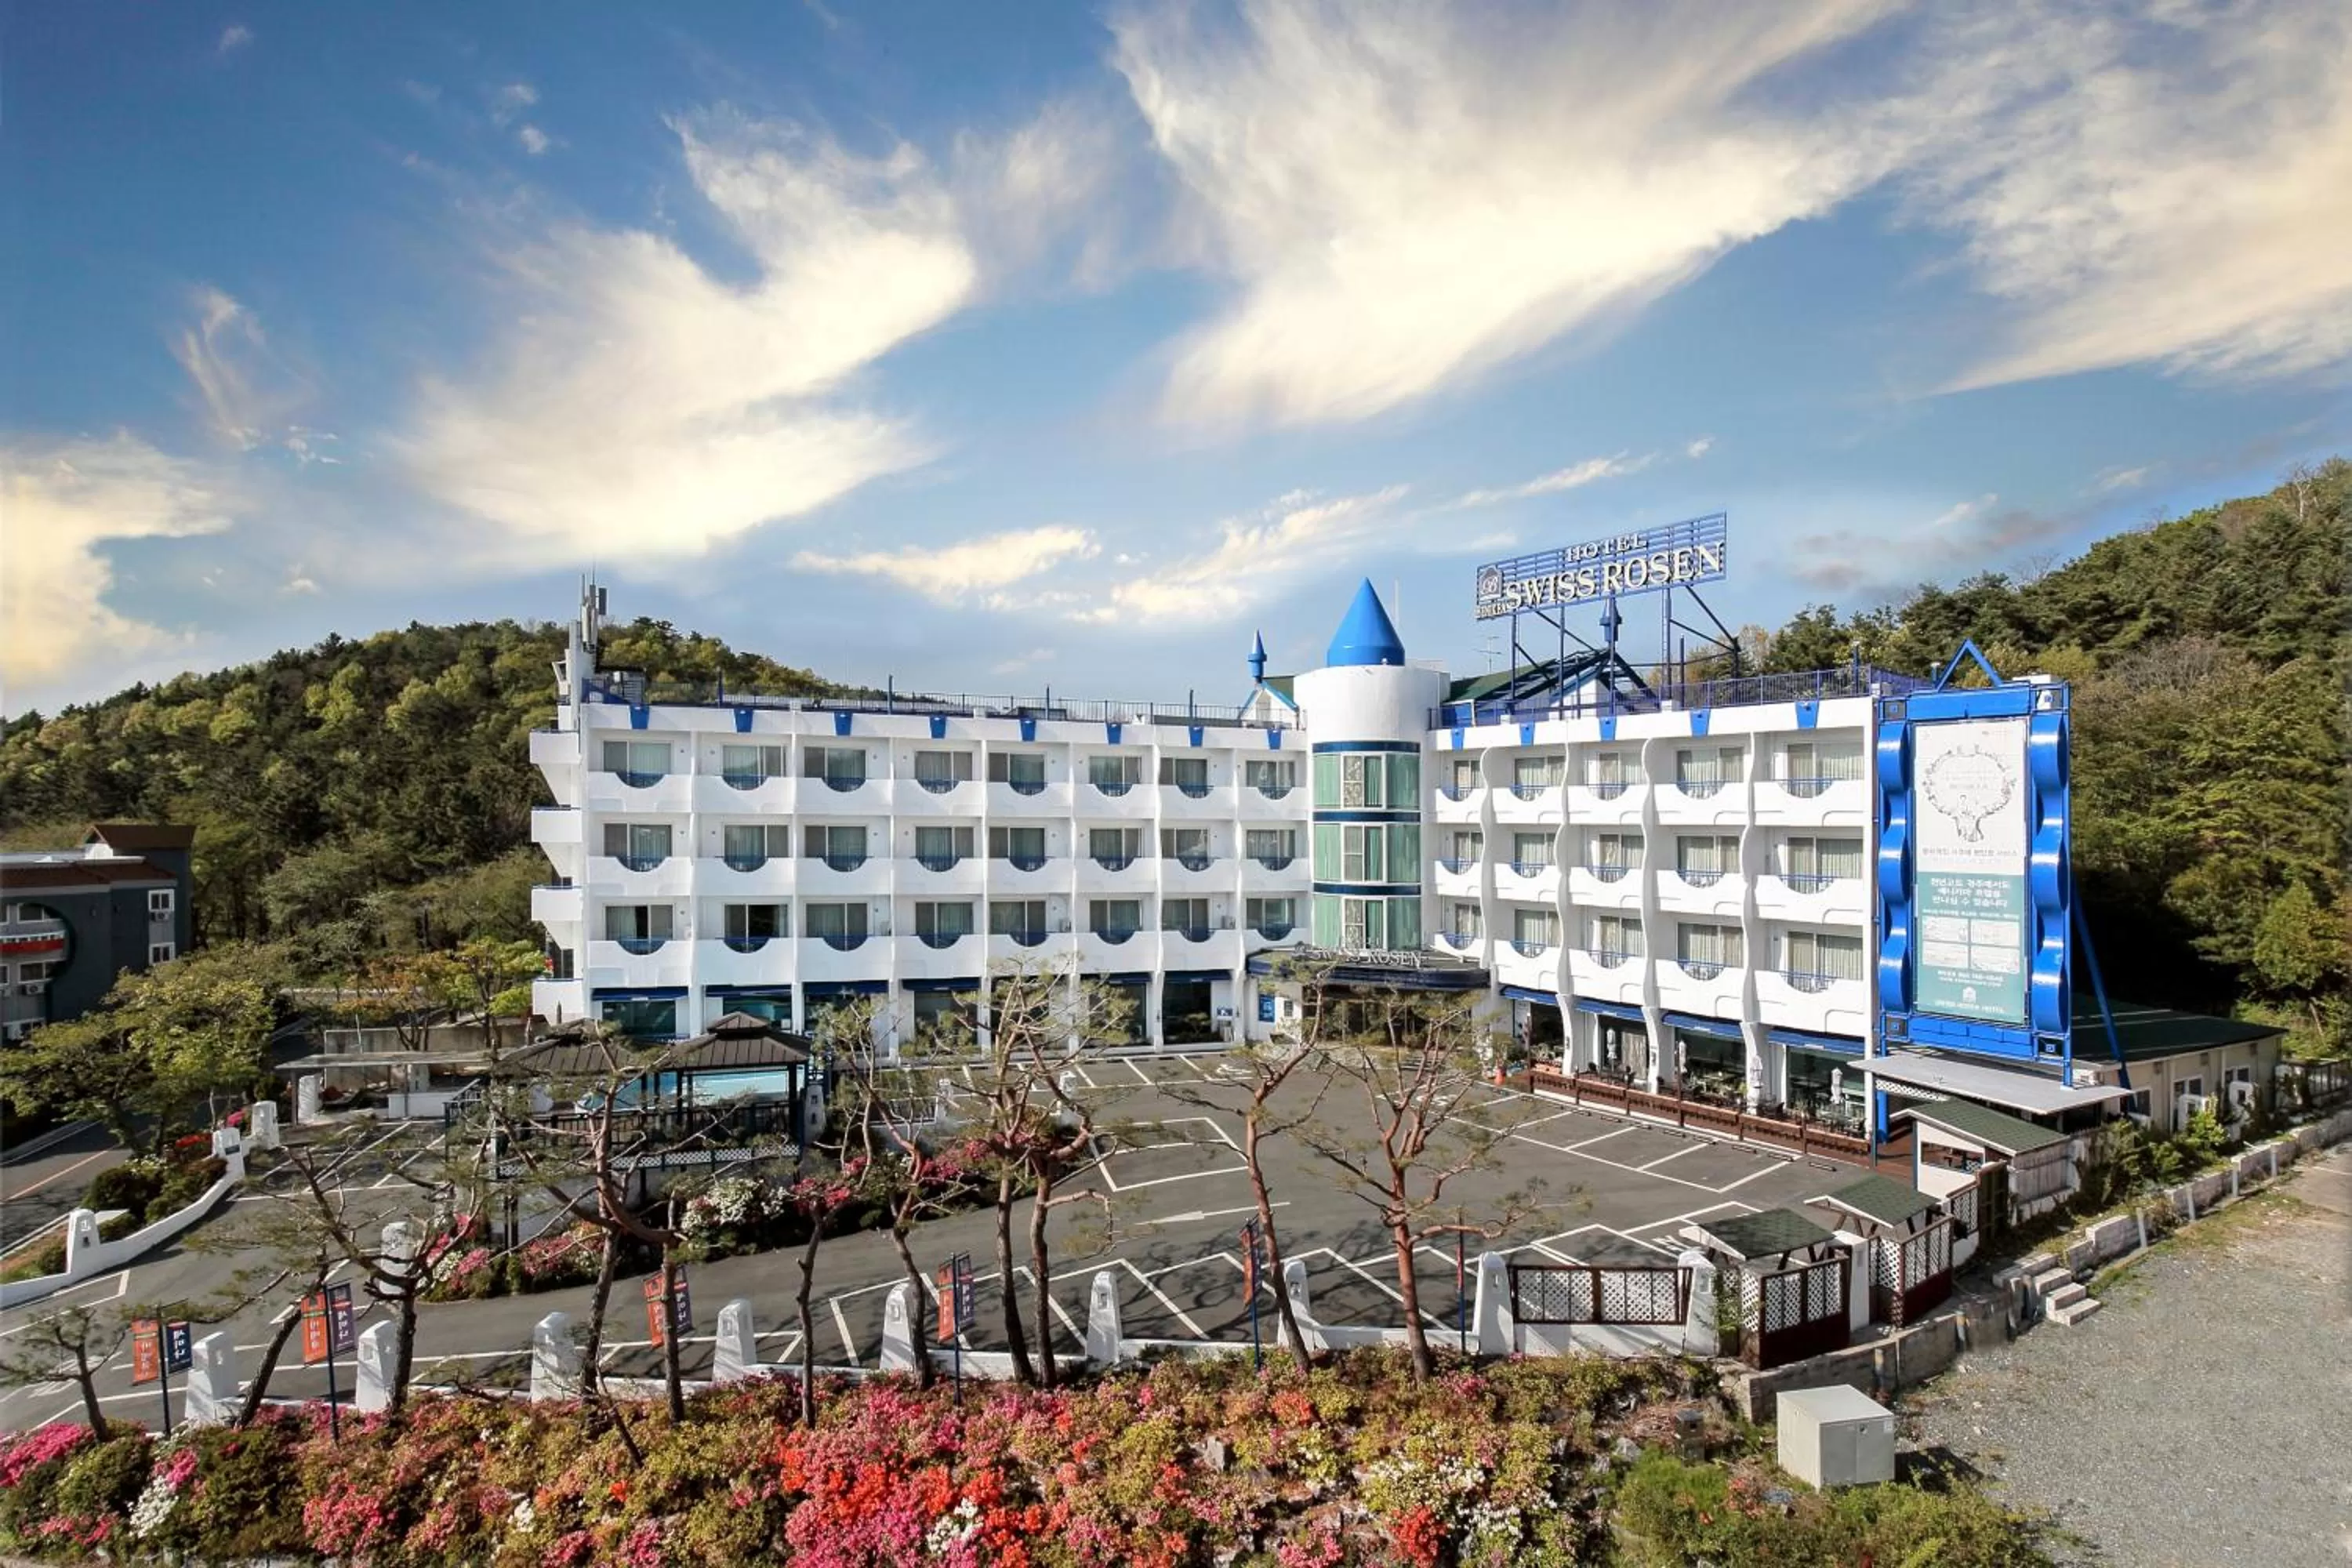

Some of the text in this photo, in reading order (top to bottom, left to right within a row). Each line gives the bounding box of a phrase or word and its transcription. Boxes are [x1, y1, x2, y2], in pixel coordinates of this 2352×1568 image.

[1566, 532, 1648, 563] HOTEL
[1504, 539, 1725, 610] SWISS ROSEN
[1367, 949, 1423, 969] ROSEN
